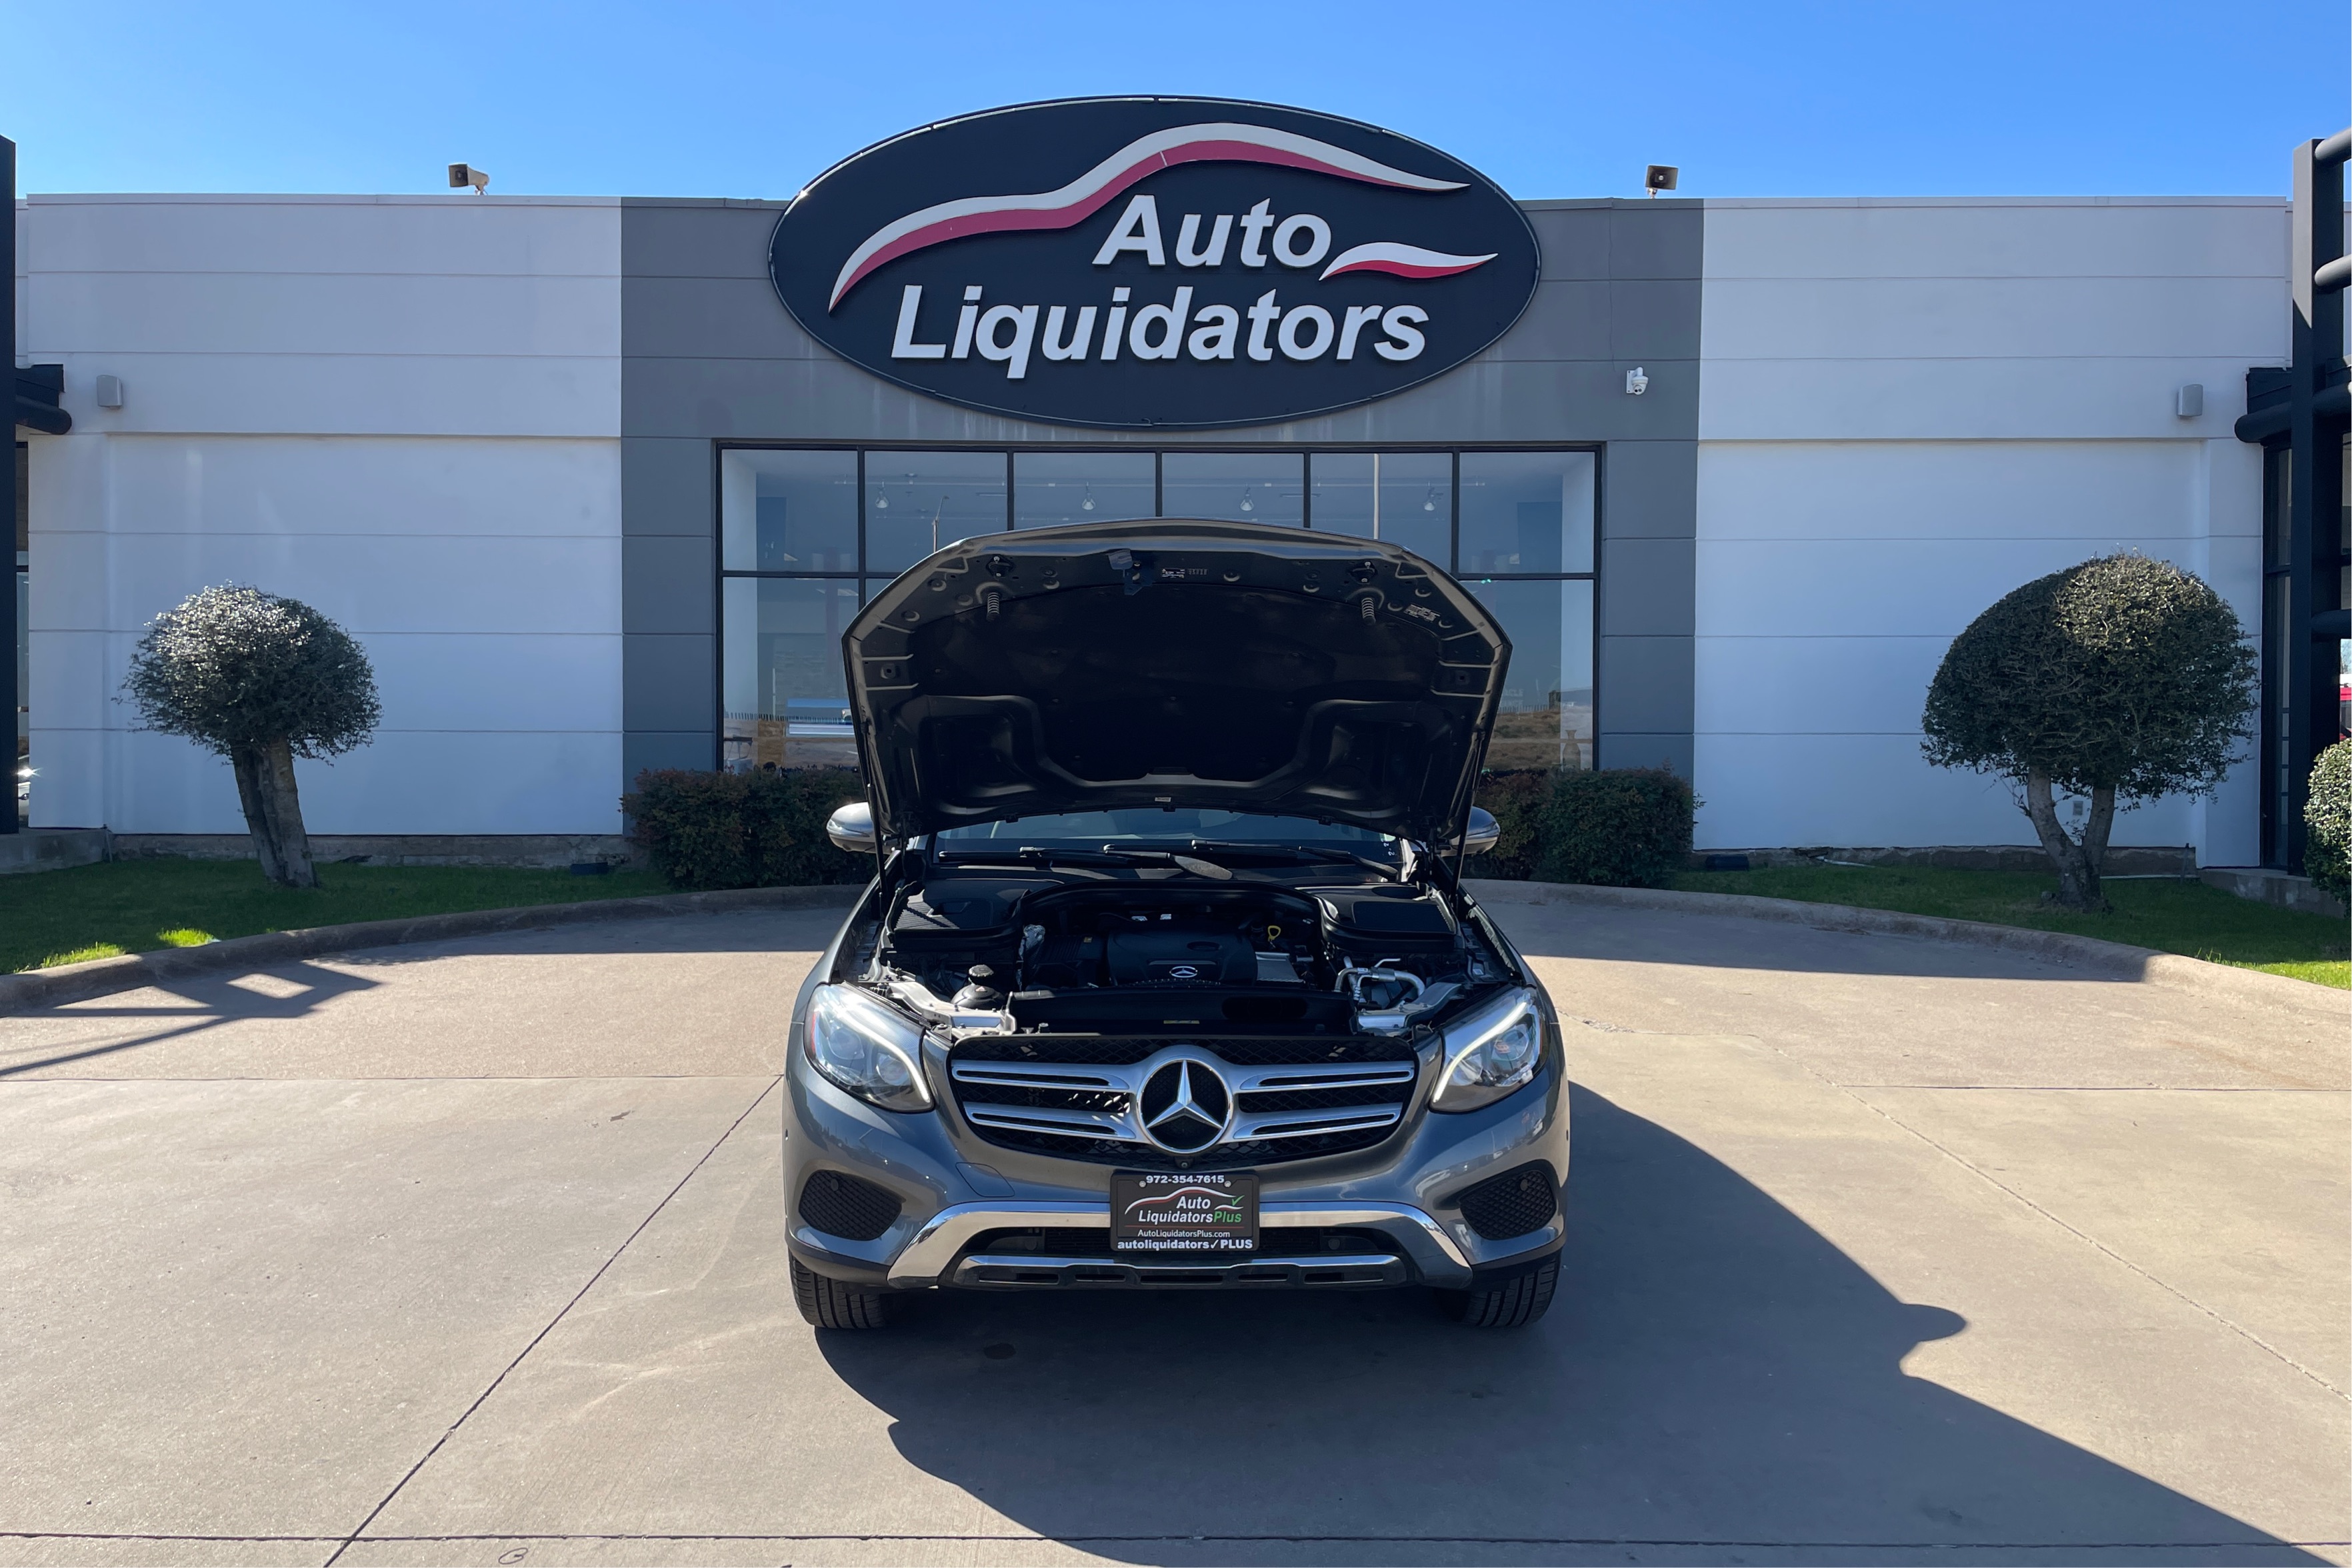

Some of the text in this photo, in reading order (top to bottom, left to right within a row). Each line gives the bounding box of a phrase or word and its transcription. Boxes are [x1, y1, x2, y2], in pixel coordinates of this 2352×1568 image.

[1091, 194, 1332, 268] Auto
[891, 284, 1429, 379] Liquidators
[1145, 1175, 1225, 1184] 972-354-7615
[1176, 1195, 1211, 1209] Auto
[1137, 1229, 1231, 1238] AutoLiquidatorsPlus.com
